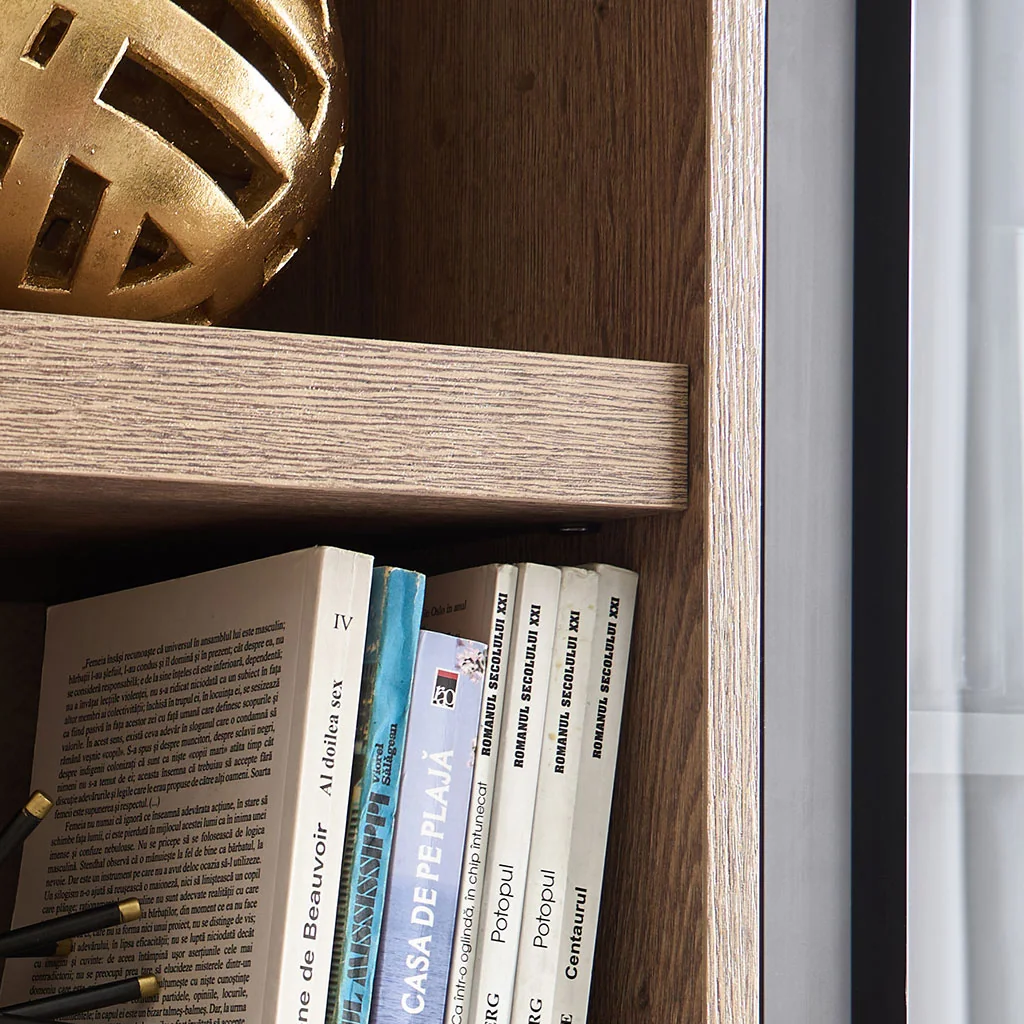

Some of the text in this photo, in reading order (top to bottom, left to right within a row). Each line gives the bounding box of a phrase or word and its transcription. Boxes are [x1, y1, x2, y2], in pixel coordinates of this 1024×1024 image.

[333, 613, 354, 631] IV
[481, 593, 508, 757] ROMANUL SECOLULUI XXI
[514, 604, 541, 768] ROMANUL SECOLULUI XXI
[555, 610, 581, 774] ROMANUL SECOLULUI XXI
[592, 597, 620, 759] ROMANUL SECOLULUI XXI
[319, 679, 344, 796] Al doilea sex
[372, 744, 384, 784] Viorel
[470, 782, 488, 850] întunecat
[303, 822, 328, 941] Beauvoir
[347, 792, 390, 987] MISSISSIPPI
[401, 750, 455, 1015] CASA DE PE PLAJĂ
[465, 889, 476, 901] în
[469, 853, 481, 885] chip
[491, 863, 514, 943] Potopul
[533, 869, 556, 948] Potopul
[299, 950, 315, 982] de
[460, 905, 475, 962] oglindă,
[565, 886, 588, 980] Centaurul
[455, 967, 467, 1001] într-o
